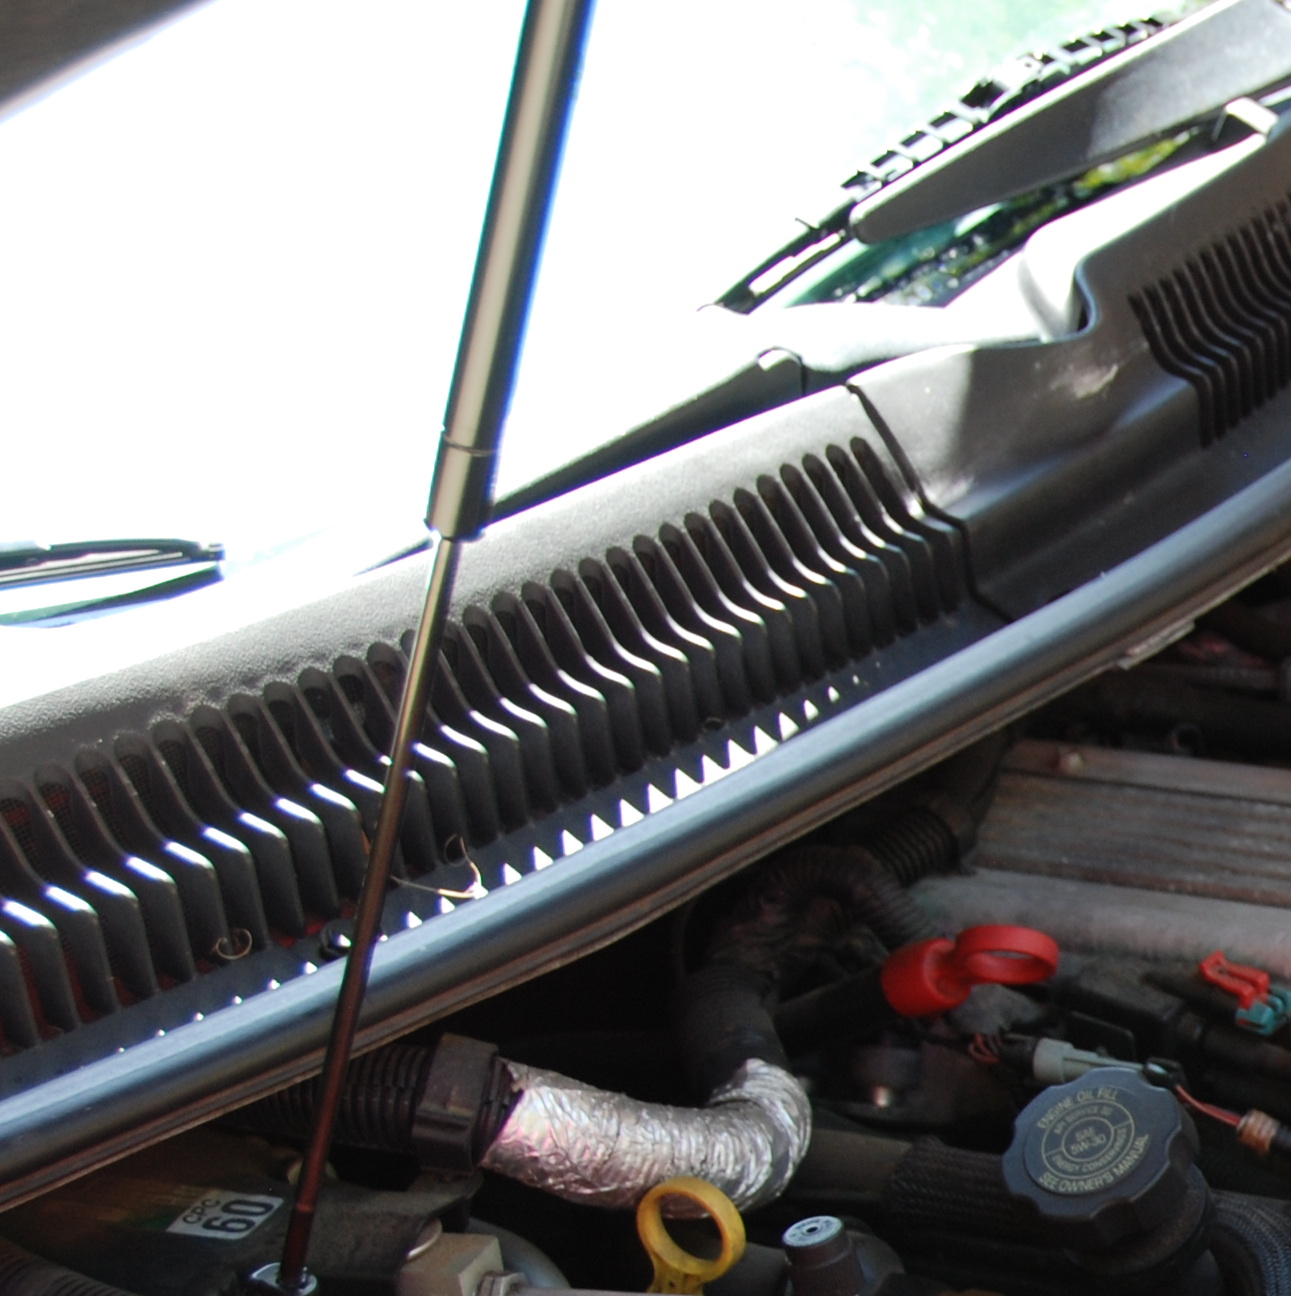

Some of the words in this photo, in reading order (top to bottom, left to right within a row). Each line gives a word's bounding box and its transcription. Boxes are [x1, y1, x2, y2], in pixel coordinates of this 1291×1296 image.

[1036, 1095, 1075, 1129] ENGINE
[1075, 1089, 1094, 1103] OIL
[1097, 1087, 1118, 1100] FILL
[1069, 1133, 1107, 1155] 5W-30
[1074, 1125, 1096, 1141] SAE
[1038, 1170, 1059, 1189] SEE
[1058, 1170, 1114, 1192] OWNER'S
[1112, 1133, 1149, 1175] MANUAL
